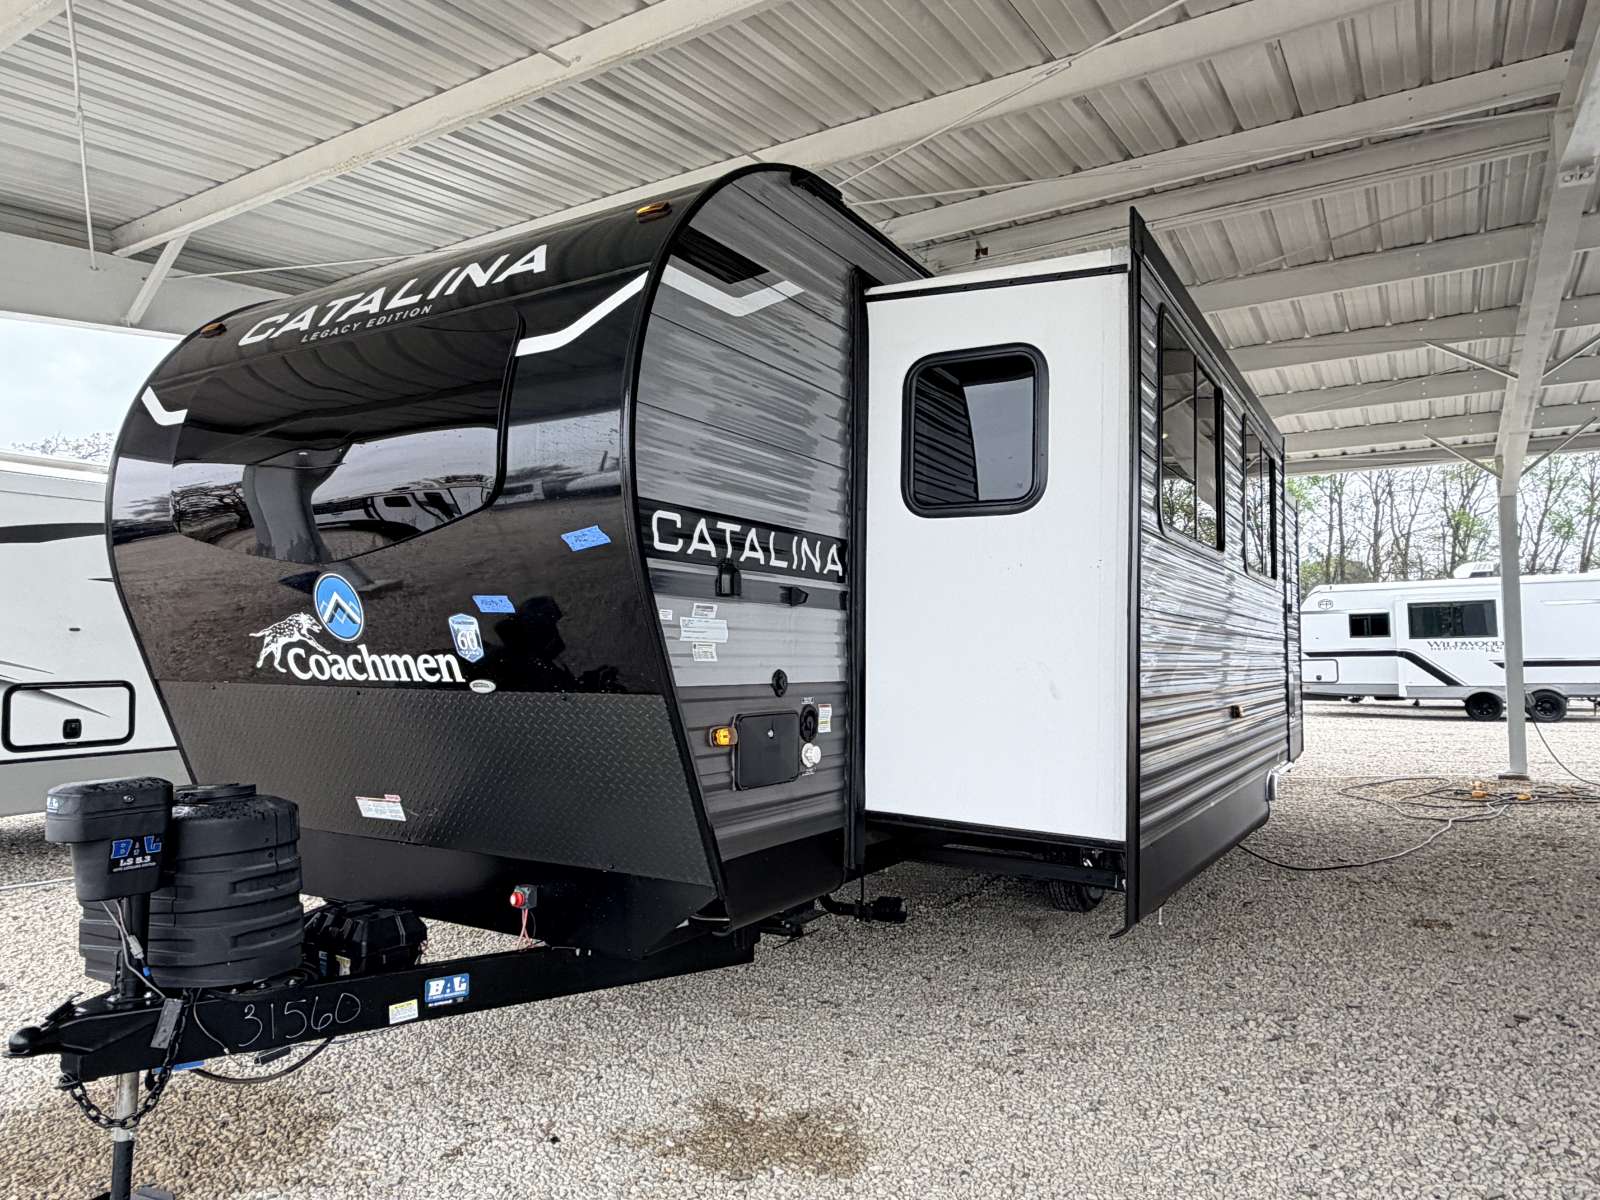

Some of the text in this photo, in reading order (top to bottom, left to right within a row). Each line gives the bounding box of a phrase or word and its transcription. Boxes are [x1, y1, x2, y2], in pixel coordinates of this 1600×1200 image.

[238, 244, 547, 347] CATALINA
[301, 304, 433, 343] LEGACY EDITION
[652, 510, 843, 576] CATALINA
[287, 644, 466, 682] Coachmen
[238, 992, 361, 1047] 31560
